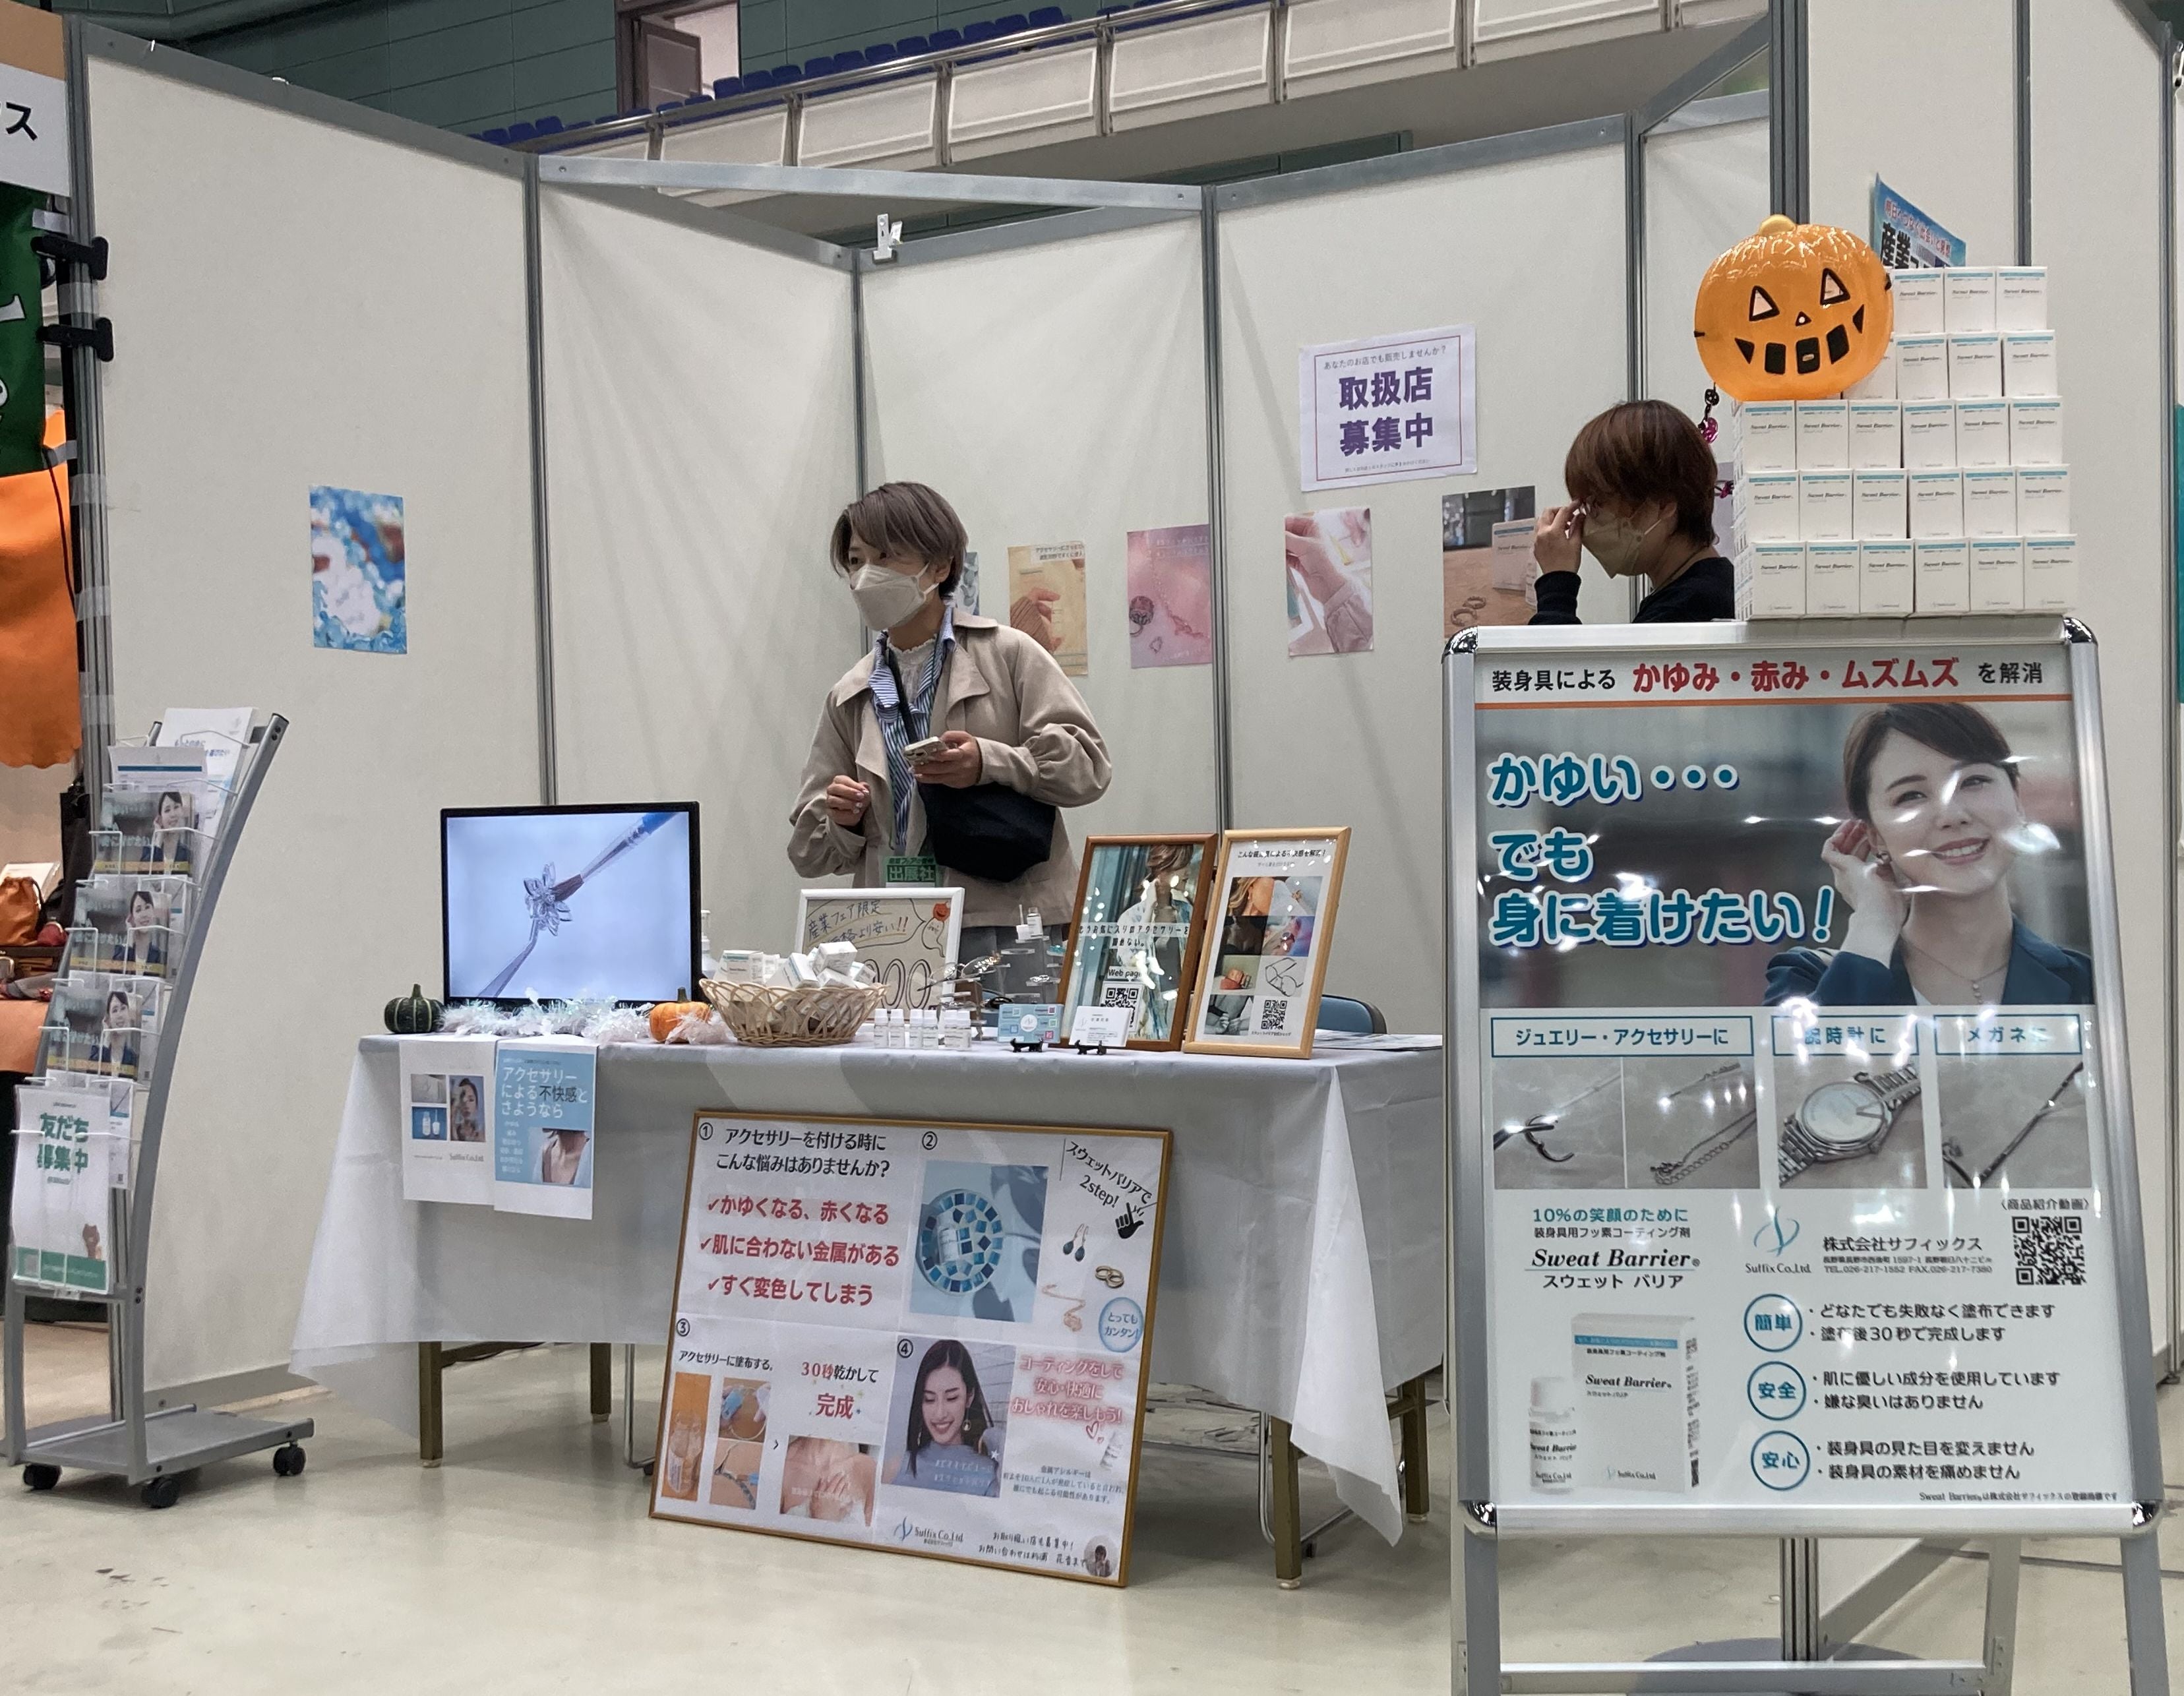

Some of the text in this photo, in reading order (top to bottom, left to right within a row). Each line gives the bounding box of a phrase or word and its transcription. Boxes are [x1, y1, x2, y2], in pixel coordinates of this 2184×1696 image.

[1339, 367, 1433, 410] 取扱店
[1340, 412, 1433, 457] 募集中
[1492, 657, 2044, 694] 装身具による かゆみ・赤み・ムズムズ を解消
[1489, 827, 1594, 884] でも
[1489, 886, 1835, 948] 身に着けたい!
[1108, 969, 1141, 979] Web pag
[1516, 1027, 1729, 1047] ジュエリー・アクセサリーに
[503, 1066, 577, 1084] アクセサリー
[501, 1083, 588, 1103] による不快感と
[502, 1101, 562, 1118] さようなら
[40, 1112, 89, 1143] 友だち
[725, 1128, 886, 1151] アクセサリーを付ける時に
[716, 1154, 890, 1178] こんな悩みはありませんか?
[1066, 1141, 1153, 1204] スウェットバリアで
[1079, 1174, 1119, 1208] 2step!
[1533, 1208, 1689, 1222] 10%の笑顔のために
[1534, 1227, 1691, 1238] 装身具用フッ素コーティング剤
[712, 1234, 899, 1267] 肌に合わない金属がある
[1823, 1236, 1982, 1252] 株式会社サフィックス
[1532, 1248, 1600, 1267] Sweat
[721, 1275, 873, 1306] すぐ変色してしまう
[1543, 1274, 1684, 1288] スウェット バリア
[1108, 1312, 1138, 1324] とっても
[1754, 1314, 1792, 1331] 簡単
[679, 1350, 773, 1372] アクセサリーに塗布する。
[1021, 1356, 1124, 1379] コーティングをして
[801, 1362, 879, 1383] 30秒乾かして
[1585, 1374, 1620, 1386] Sweat
[1758, 1381, 1797, 1399] 安全
[816, 1393, 855, 1419] 完成
[1761, 1451, 1800, 1469] 安心
